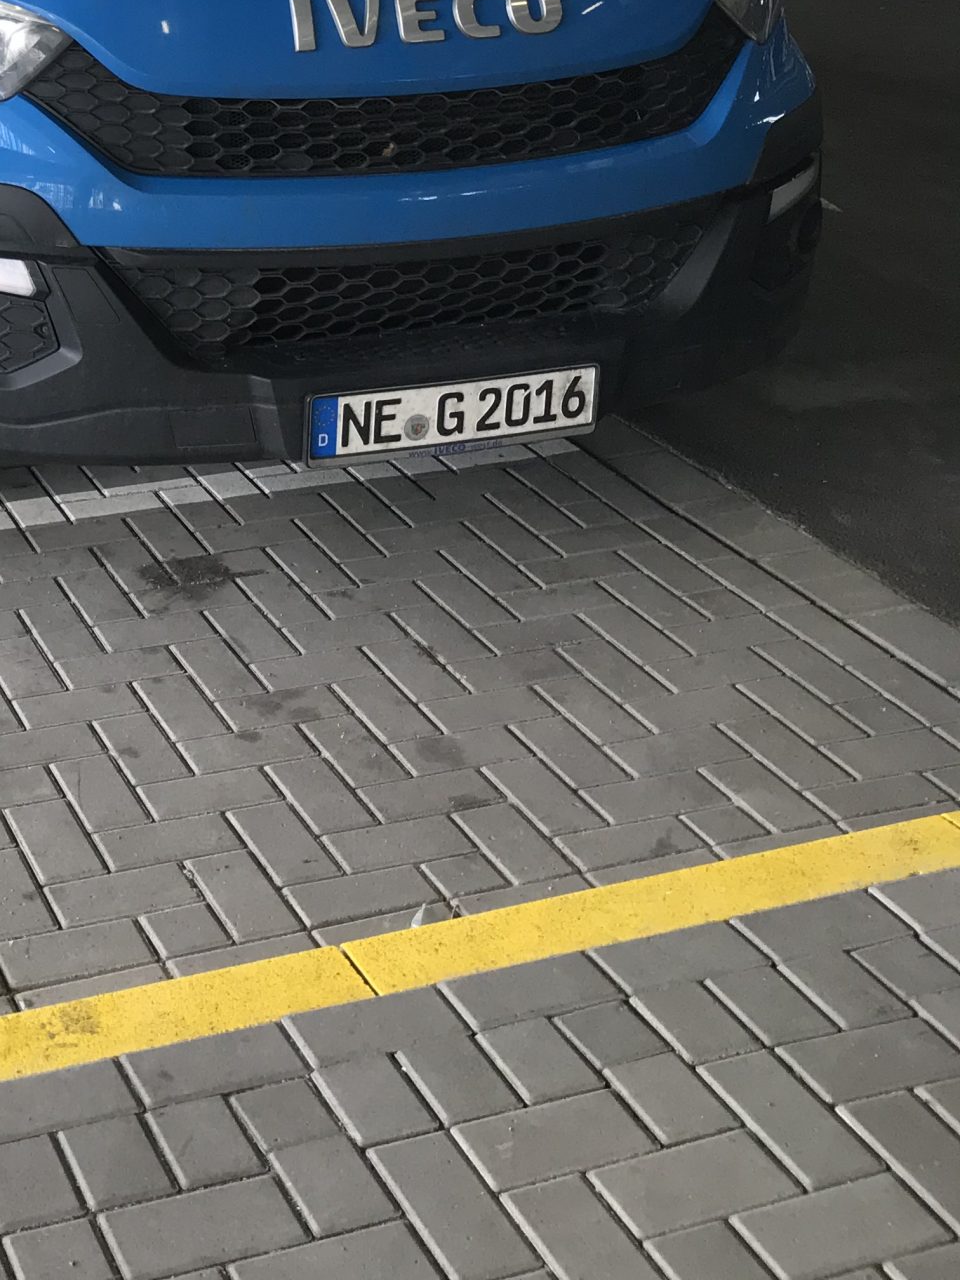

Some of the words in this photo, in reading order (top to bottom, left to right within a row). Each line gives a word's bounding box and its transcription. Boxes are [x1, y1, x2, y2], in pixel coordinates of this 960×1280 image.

[341, 398, 402, 448] NE
[436, 392, 465, 437] G
[476, 375, 587, 432] 2016
[318, 433, 329, 447] D
